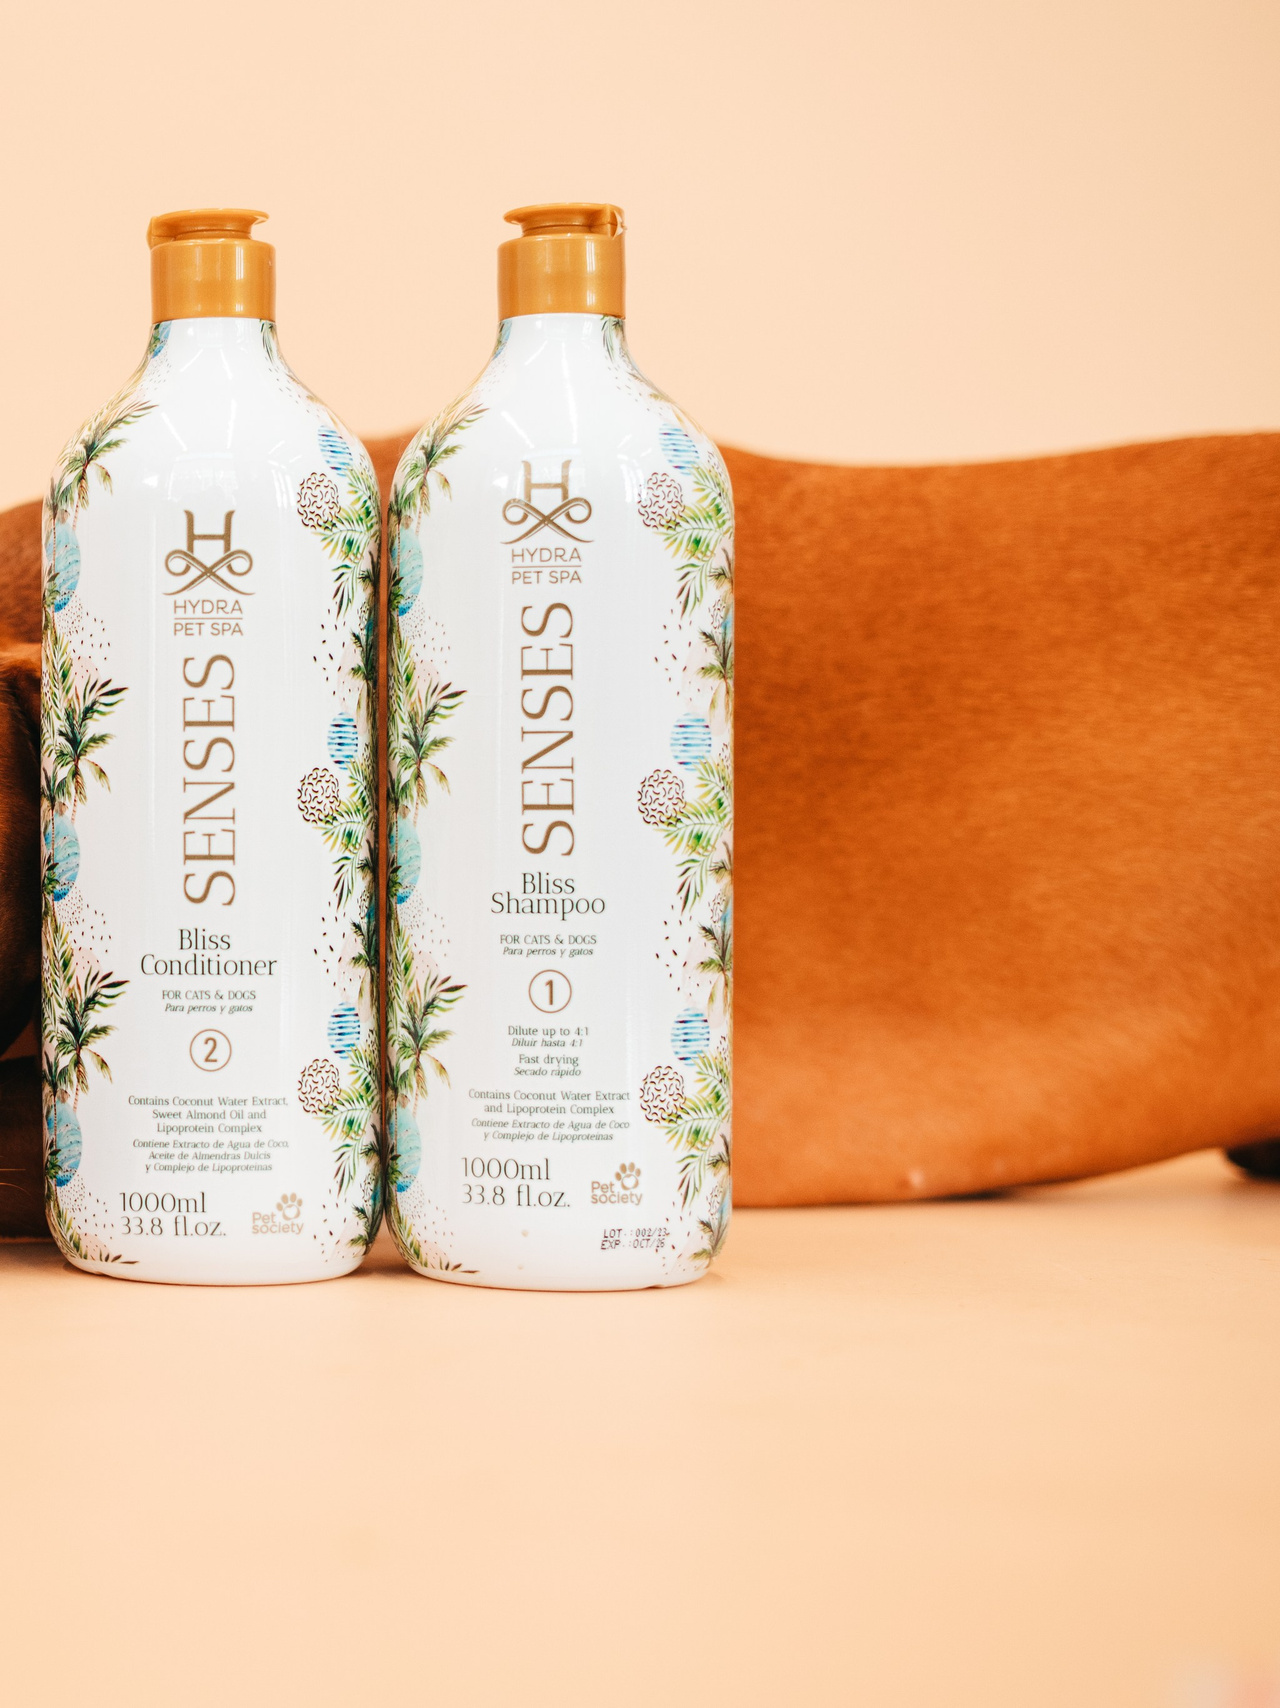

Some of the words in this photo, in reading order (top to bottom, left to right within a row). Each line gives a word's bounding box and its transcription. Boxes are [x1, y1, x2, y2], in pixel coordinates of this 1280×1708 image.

[512, 548, 581, 562] HYDRA
[512, 571, 542, 584] PET
[549, 570, 581, 583] SPA
[174, 600, 243, 614] HYDRA
[174, 623, 204, 636] PET
[211, 623, 243, 636] SPA
[521, 602, 574, 856] SENSES
[183, 654, 235, 906] SENSES
[522, 872, 574, 894] Bliss
[491, 891, 605, 921] Shampoo
[179, 928, 231, 950] Bliss
[500, 935, 519, 944] FOR
[524, 935, 550, 944] CATS
[555, 935, 564, 944] &
[569, 935, 596, 944] DOGS
[503, 947, 522, 955] Para
[526, 948, 556, 957] perros
[560, 949, 565, 957] y
[569, 947, 593, 957] gatos
[141, 954, 277, 975] Conditioner
[162, 990, 181, 1000] FOR
[185, 990, 210, 1000] CATS
[215, 990, 223, 1000] &
[228, 990, 256, 1000] DOGS
[165, 1003, 184, 1012] Para
[187, 1005, 216, 1014] perros
[220, 1005, 226, 1014] y
[229, 1004, 253, 1014] gatos
[508, 1026, 538, 1036] Dilute
[543, 1028, 556, 1038] up
[560, 1027, 570, 1036] to
[575, 1027, 588, 1036] 4:1
[512, 1038, 537, 1047] Diluir
[541, 1039, 565, 1047] hasta
[570, 1039, 583, 1047] 4:1
[204, 1037, 218, 1062] 2
[519, 1054, 539, 1064] Fast
[544, 1054, 579, 1067] drying
[514, 1067, 547, 1076] Secado
[128, 1095, 169, 1106] Contains
[173, 1097, 213, 1106] Coconut
[218, 1097, 248, 1106] Water
[469, 1089, 510, 1099] Contains
[514, 1090, 556, 1100] Coconut
[561, 1091, 590, 1100] Water
[596, 1091, 630, 1100] Extract
[152, 1110, 181, 1119] Sweet
[186, 1110, 225, 1119] Almond
[230, 1110, 243, 1119] Oil
[248, 1110, 266, 1119] and
[484, 1103, 502, 1112] and
[507, 1104, 566, 1116] Lipoprotein
[570, 1104, 614, 1115] Complex
[157, 1123, 214, 1134] Lipoprotein
[218, 1123, 262, 1134] Complex
[472, 1118, 509, 1127] Contiene
[512, 1120, 550, 1129] Extracto
[553, 1120, 565, 1129] de
[569, 1121, 591, 1131] Agua
[595, 1120, 606, 1129] de
[609, 1120, 629, 1129] Coco
[484, 1132, 489, 1141] y
[492, 1130, 534, 1142] Complejo
[538, 1132, 549, 1140] de
[133, 1139, 169, 1148] Contiene
[173, 1140, 209, 1148] Extracto
[213, 1140, 224, 1148] de
[228, 1140, 250, 1150] Agua
[254, 1139, 265, 1148] de
[149, 1151, 174, 1159] Aceite
[178, 1151, 188, 1159] de
[192, 1151, 240, 1160] Almendras
[244, 1151, 270, 1160] Dulcis
[145, 1164, 150, 1173] y
[154, 1163, 194, 1173] Complejo
[198, 1163, 209, 1171] de
[461, 1157, 549, 1180] 1000ml
[591, 1181, 614, 1193] Pet
[462, 1184, 505, 1206] 33.8
[591, 1192, 642, 1206] society
[119, 1191, 206, 1213] 1000ml
[252, 1212, 275, 1224] Pet
[121, 1216, 163, 1236] 33.8
[252, 1223, 304, 1234] society
